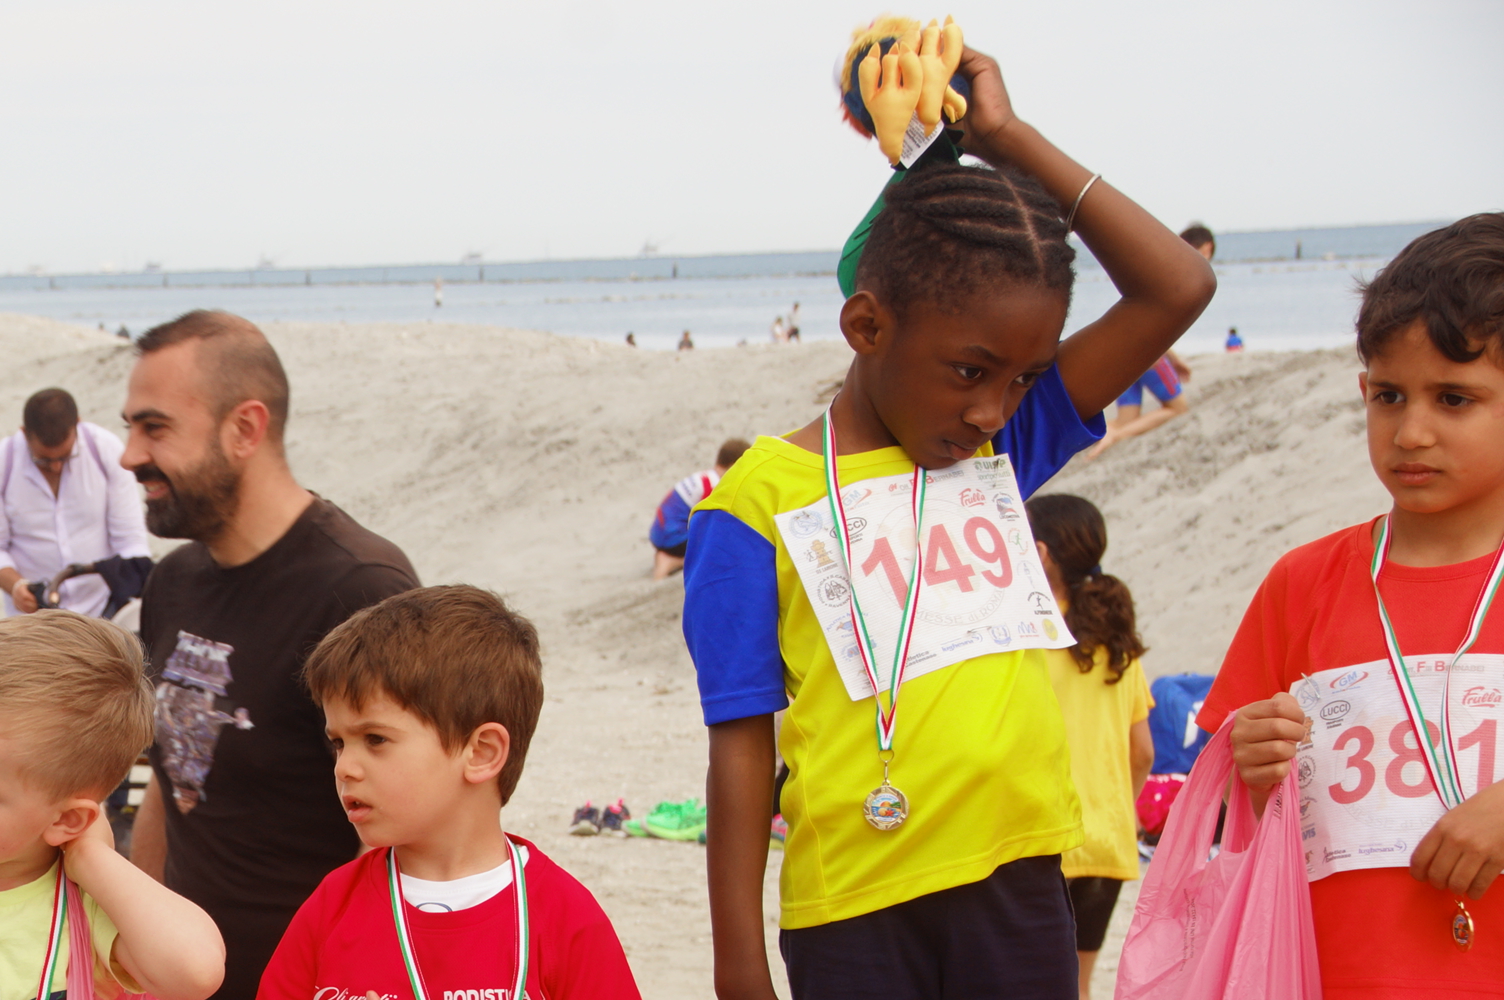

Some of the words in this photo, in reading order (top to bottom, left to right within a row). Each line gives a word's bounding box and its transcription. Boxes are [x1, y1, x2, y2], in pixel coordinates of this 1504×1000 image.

[860, 515, 1014, 612] 149
[1338, 671, 1358, 688] GM
[1322, 703, 1348, 717] LUCCI
[1328, 718, 1498, 805] 381
